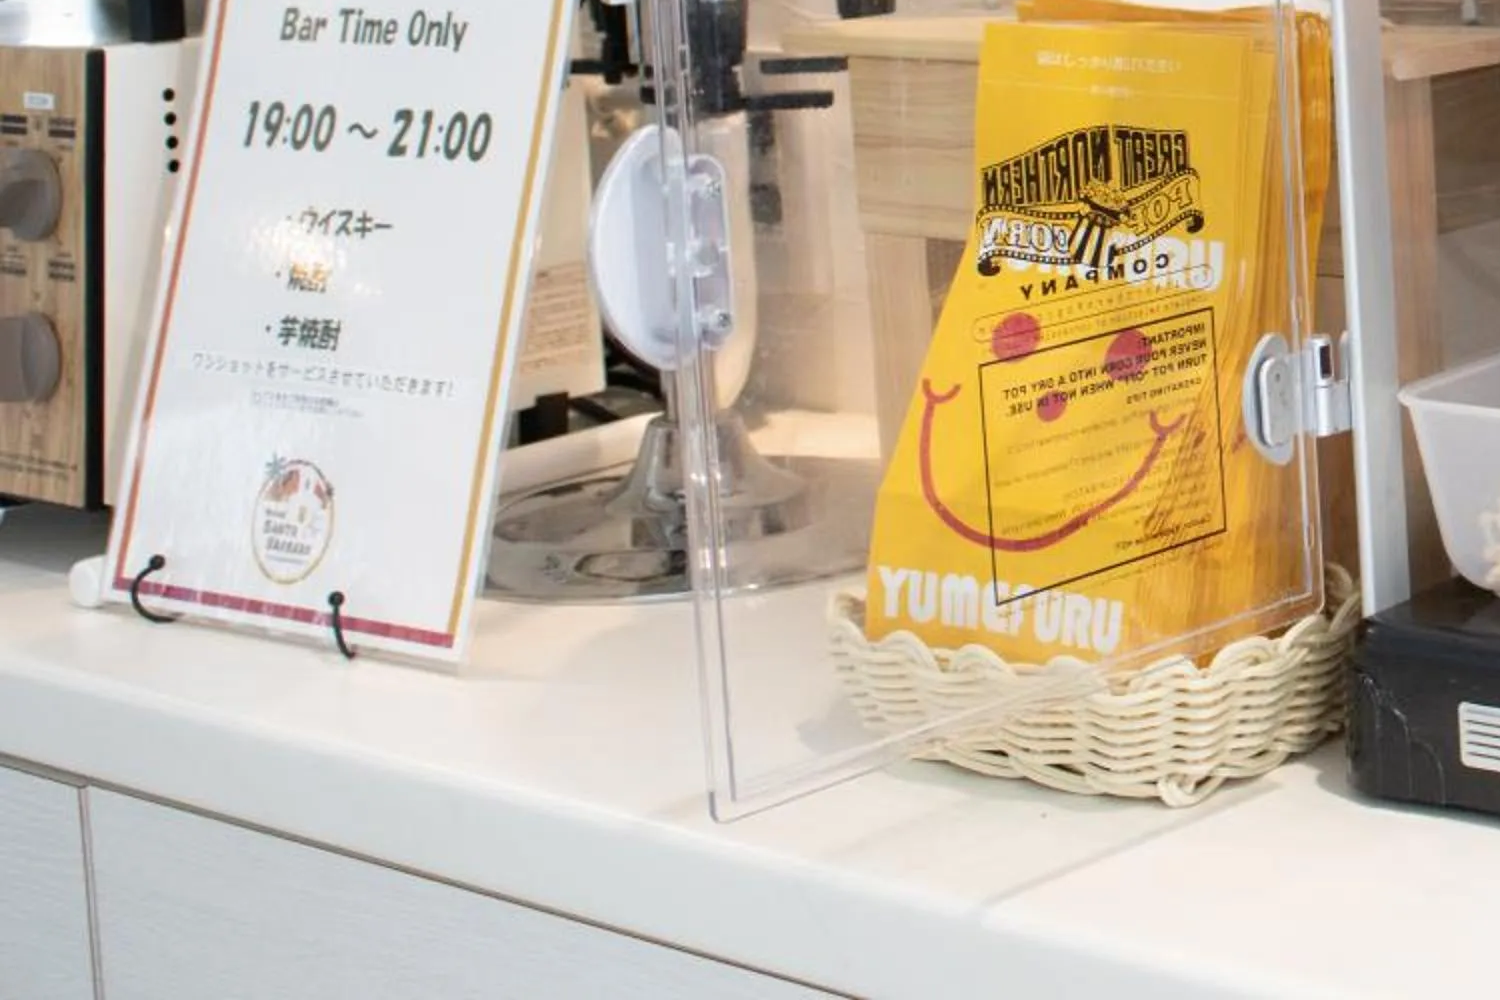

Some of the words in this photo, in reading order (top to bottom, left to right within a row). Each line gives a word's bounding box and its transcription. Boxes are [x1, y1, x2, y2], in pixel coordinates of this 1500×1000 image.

[280, 7, 327, 41] Bar
[339, 8, 399, 45] Time
[407, 9, 469, 53] Only
[244, 100, 337, 152] 19:00
[387, 108, 493, 162] 21:00
[876, 564, 1126, 657] YUMEFURU
